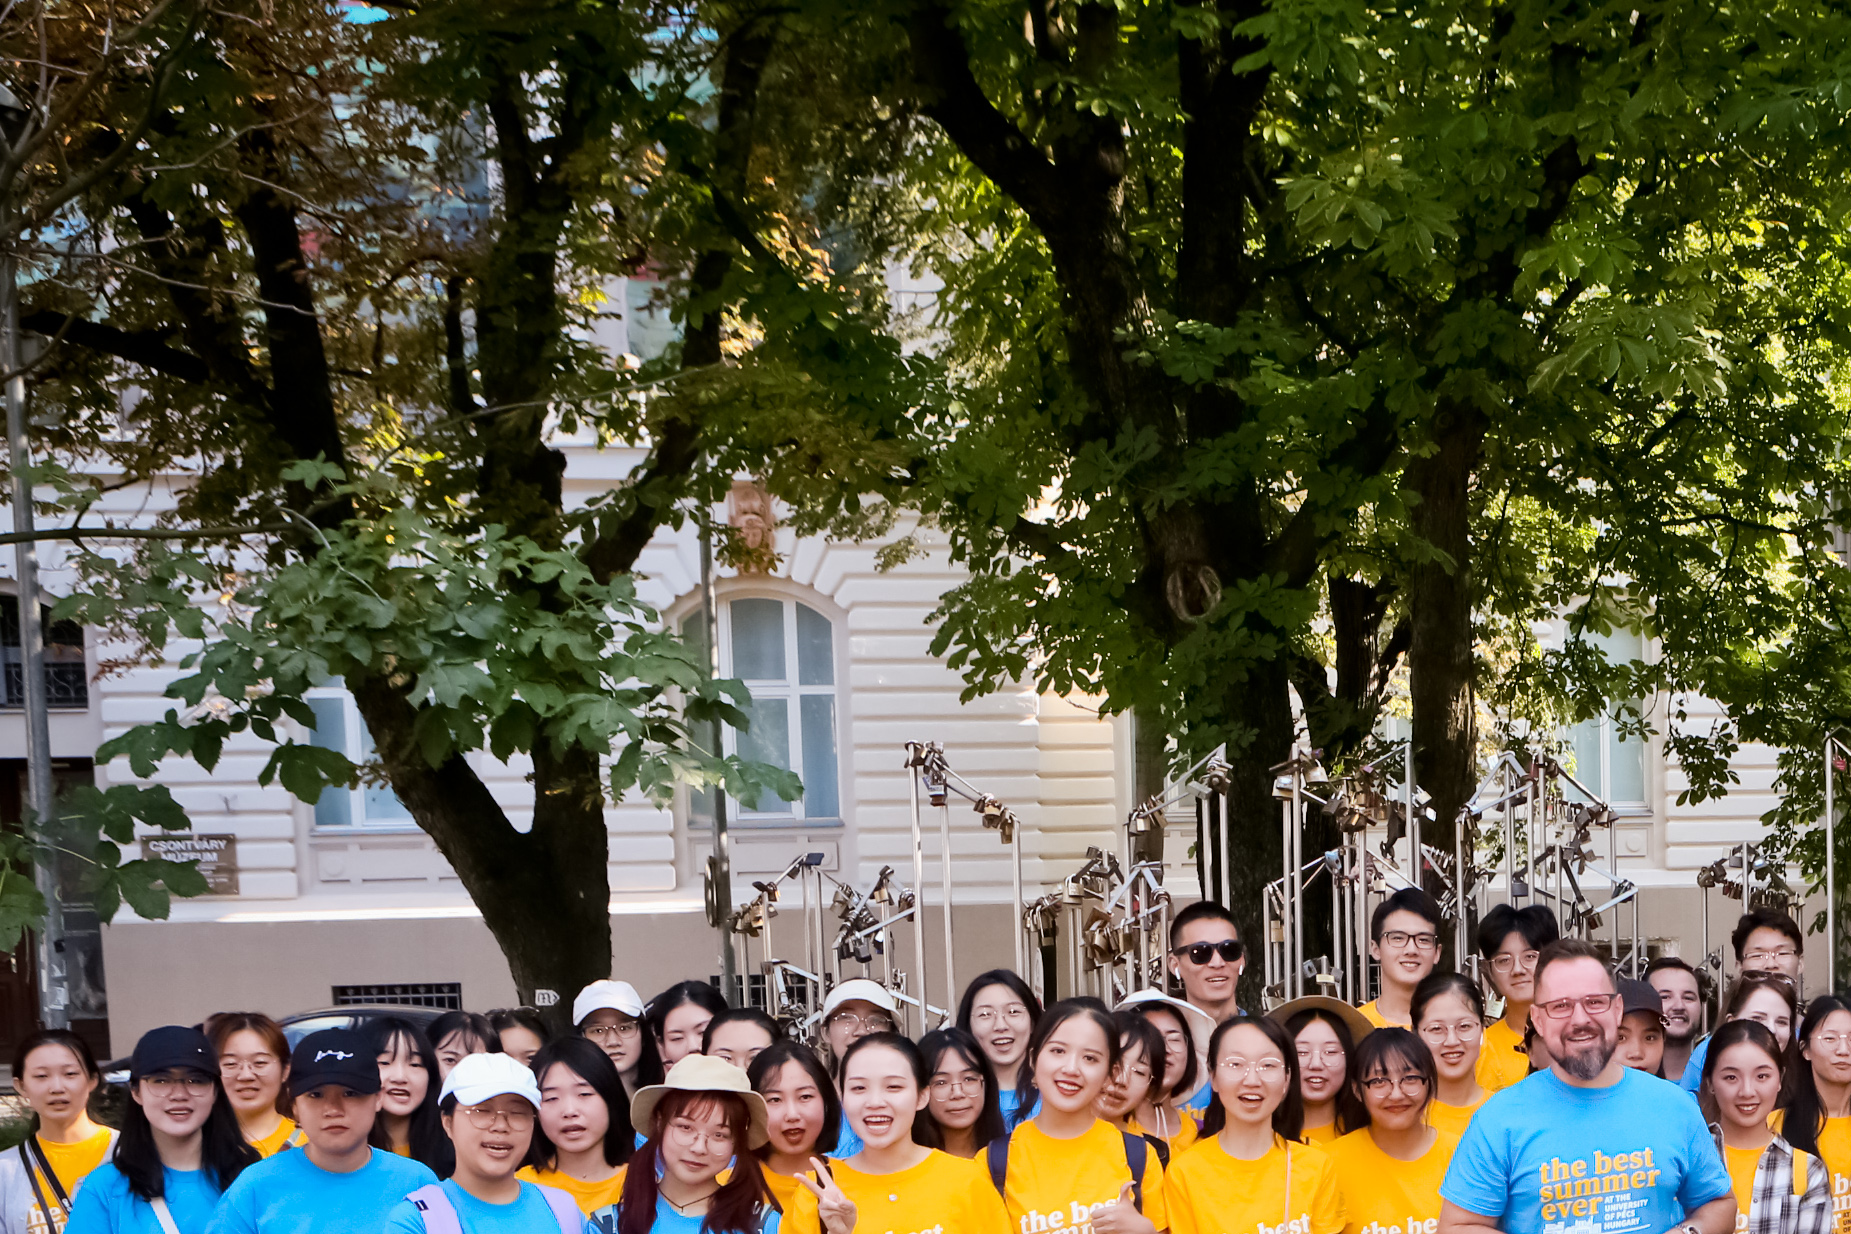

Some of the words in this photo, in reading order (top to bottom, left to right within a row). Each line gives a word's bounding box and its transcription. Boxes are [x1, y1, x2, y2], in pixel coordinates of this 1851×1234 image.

[1539, 1157, 1587, 1184] the
[1593, 1147, 1654, 1175] best
[1540, 1169, 1661, 1203] summer
[1604, 1195, 1615, 1203] AT
[1616, 1193, 1631, 1201] THE
[1541, 1196, 1603, 1221] ever
[1604, 1199, 1648, 1212] UNIVERSITY
[1604, 1212, 1615, 1221] OF
[1616, 1208, 1635, 1219] PÉCS
[1603, 1217, 1640, 1230] HUNGARY
